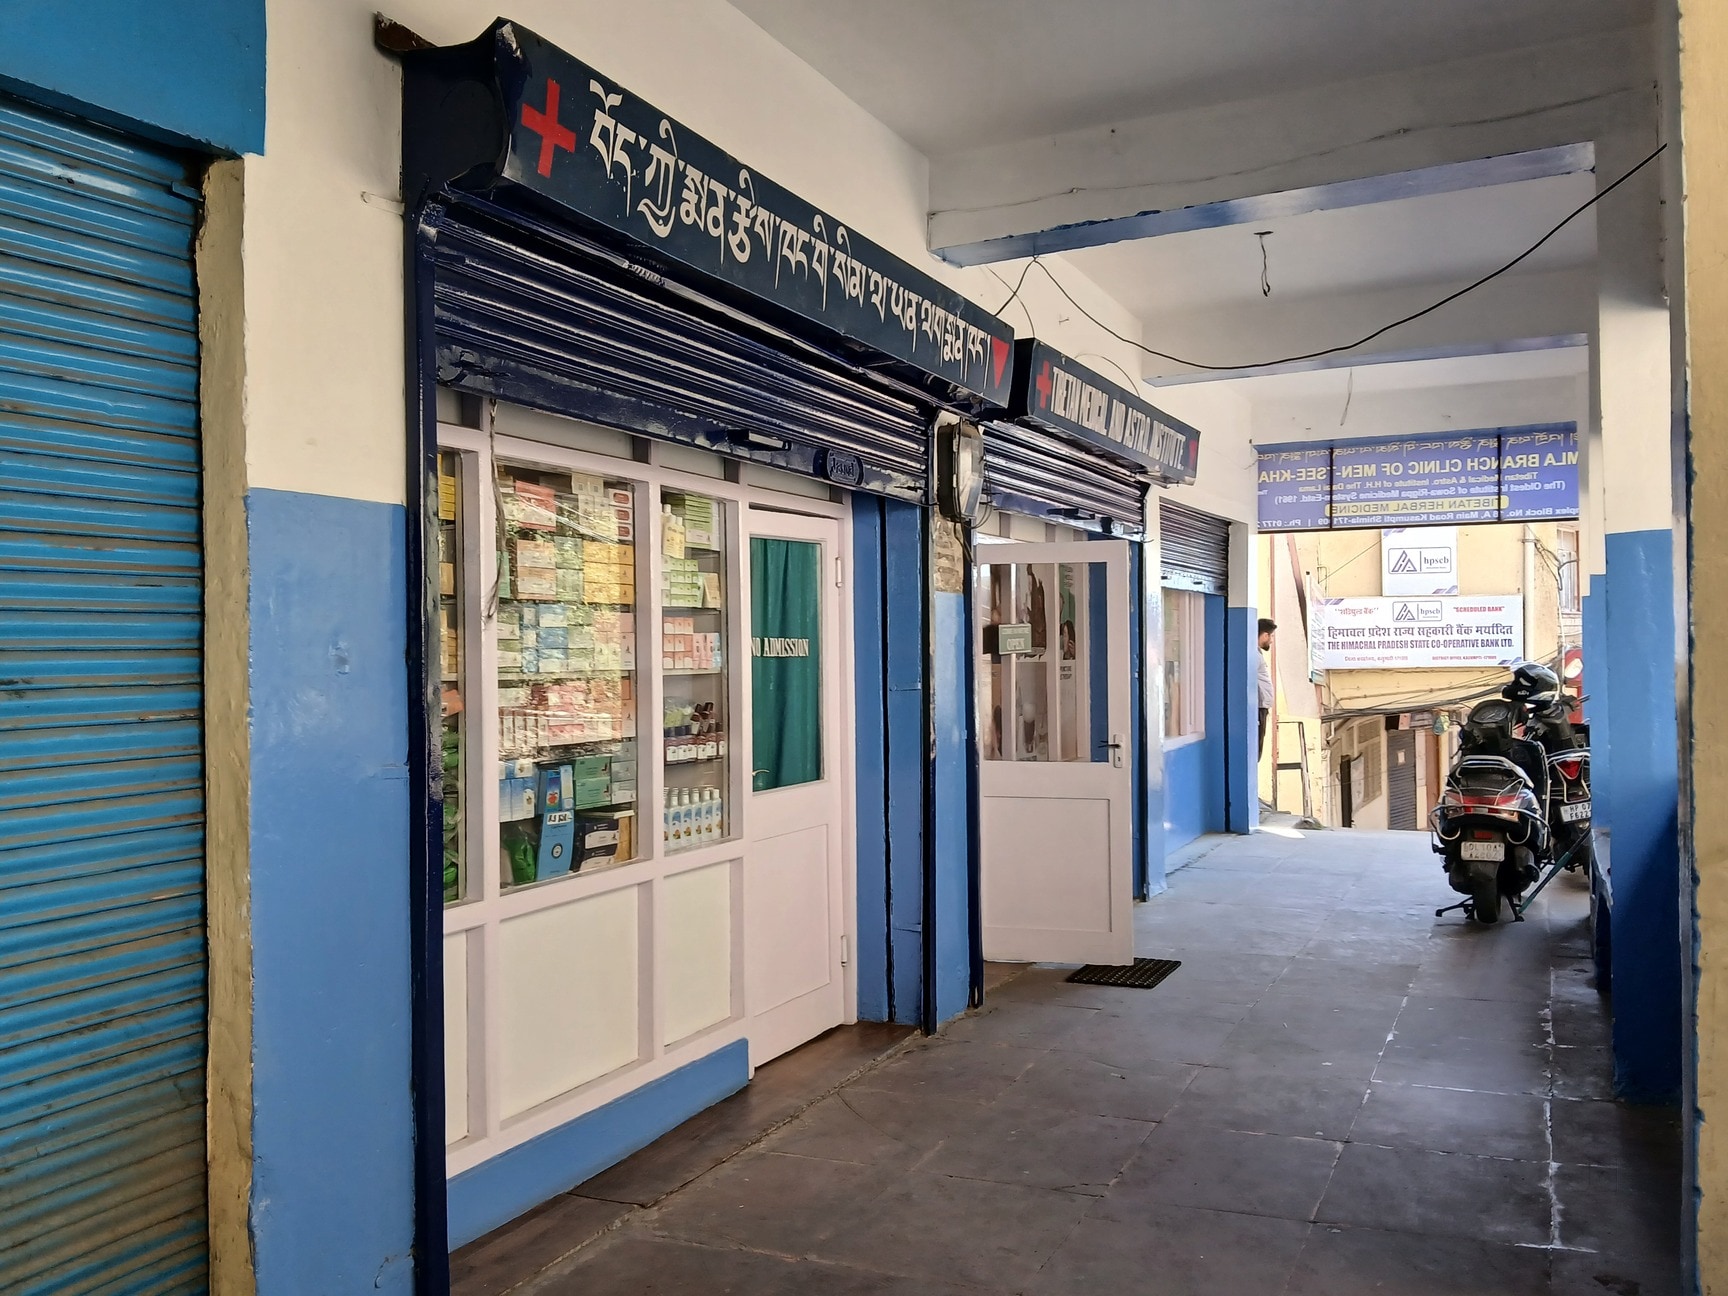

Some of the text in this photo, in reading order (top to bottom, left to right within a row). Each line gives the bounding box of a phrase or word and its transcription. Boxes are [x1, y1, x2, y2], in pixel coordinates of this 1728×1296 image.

[1148, 420, 1186, 471] INSTITUTE
[1423, 556, 1449, 566] hpscb
[1420, 608, 1440, 616] hpscb
[1368, 624, 1391, 638] प्रदेश
[1393, 626, 1415, 636] राज्य
[1417, 624, 1454, 637] सहकारी
[1455, 623, 1473, 635] बैंक
[763, 637, 809, 657] ADMISSION
[1327, 638, 1515, 650] THE HIMACHAL PRADESH STATE CO-OPERATIVE BANK LTD.
[1569, 804, 1579, 813] HP
